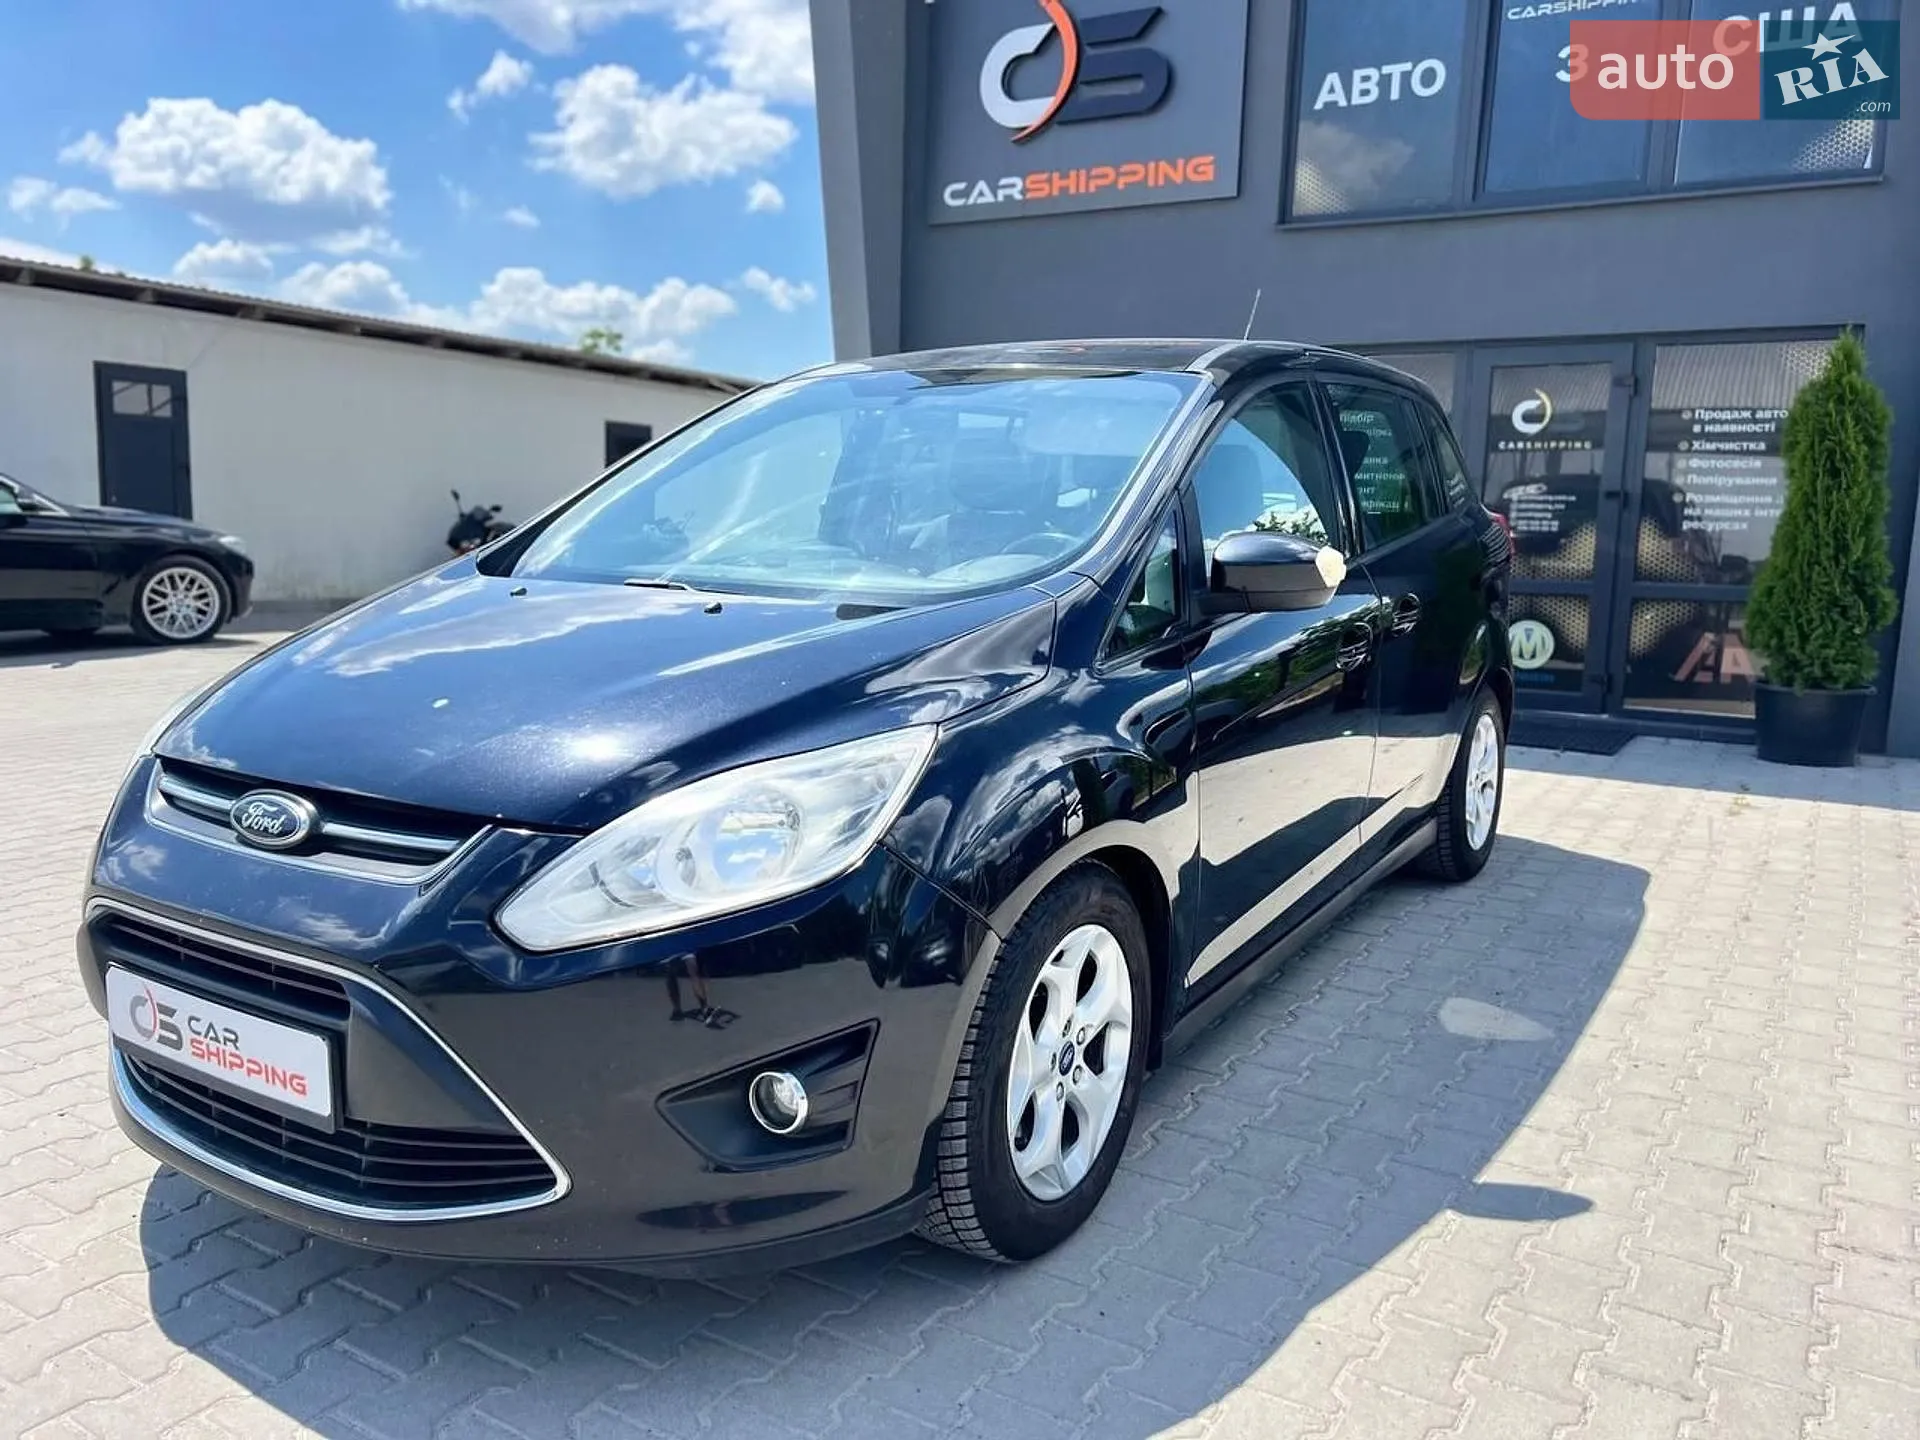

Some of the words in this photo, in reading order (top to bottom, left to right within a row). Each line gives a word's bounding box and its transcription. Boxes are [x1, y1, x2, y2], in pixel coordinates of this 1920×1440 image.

[1313, 58, 1447, 110] АВТО
[942, 154, 1216, 207] CARSHIPPING
[1694, 407, 1752, 421] Продаж
[1703, 421, 1776, 434] наявності
[1691, 439, 1767, 452] Хімчистка
[241, 802, 287, 834] Ford
[187, 1014, 240, 1051] CAR
[189, 1037, 308, 1097] SHIPPING
